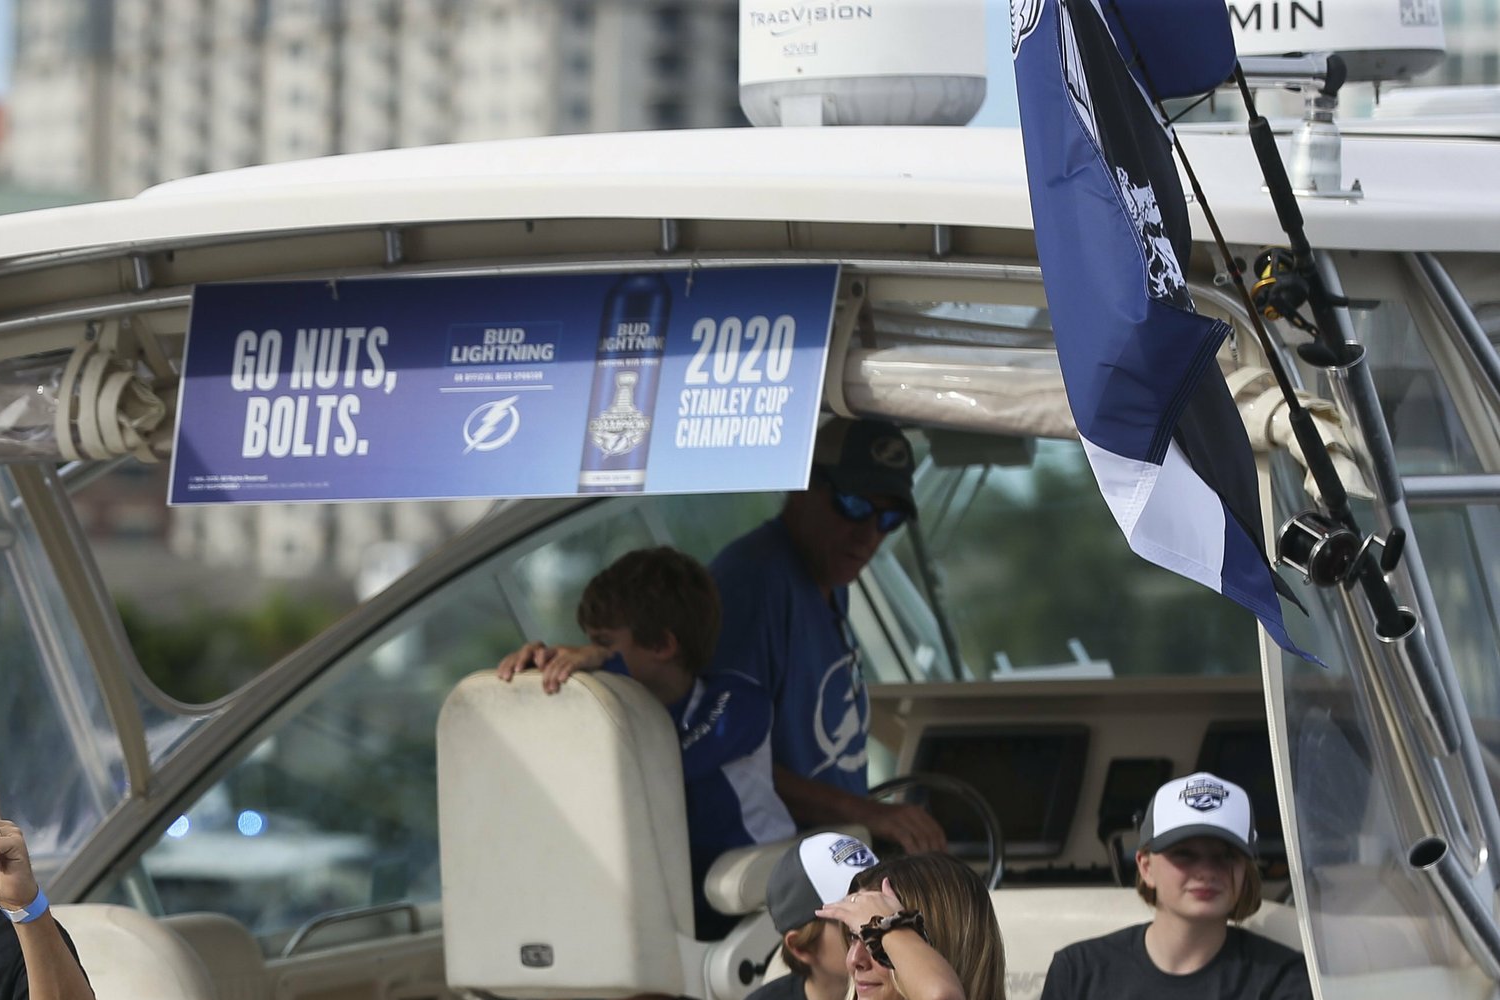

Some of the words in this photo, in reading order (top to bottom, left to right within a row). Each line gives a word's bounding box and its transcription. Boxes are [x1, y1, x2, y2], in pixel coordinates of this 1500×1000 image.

[1229, 0, 1324, 30] MIN
[483, 328, 526, 345] BUD
[617, 323, 650, 336] BUD
[231, 329, 283, 392] GO
[289, 326, 397, 394] NUTS,
[451, 343, 555, 364] LIGHTNING
[684, 314, 796, 385] 2020
[678, 387, 752, 417] STANLEY
[241, 393, 369, 458] BOLTS.
[675, 415, 784, 449] CHAMPIONS
